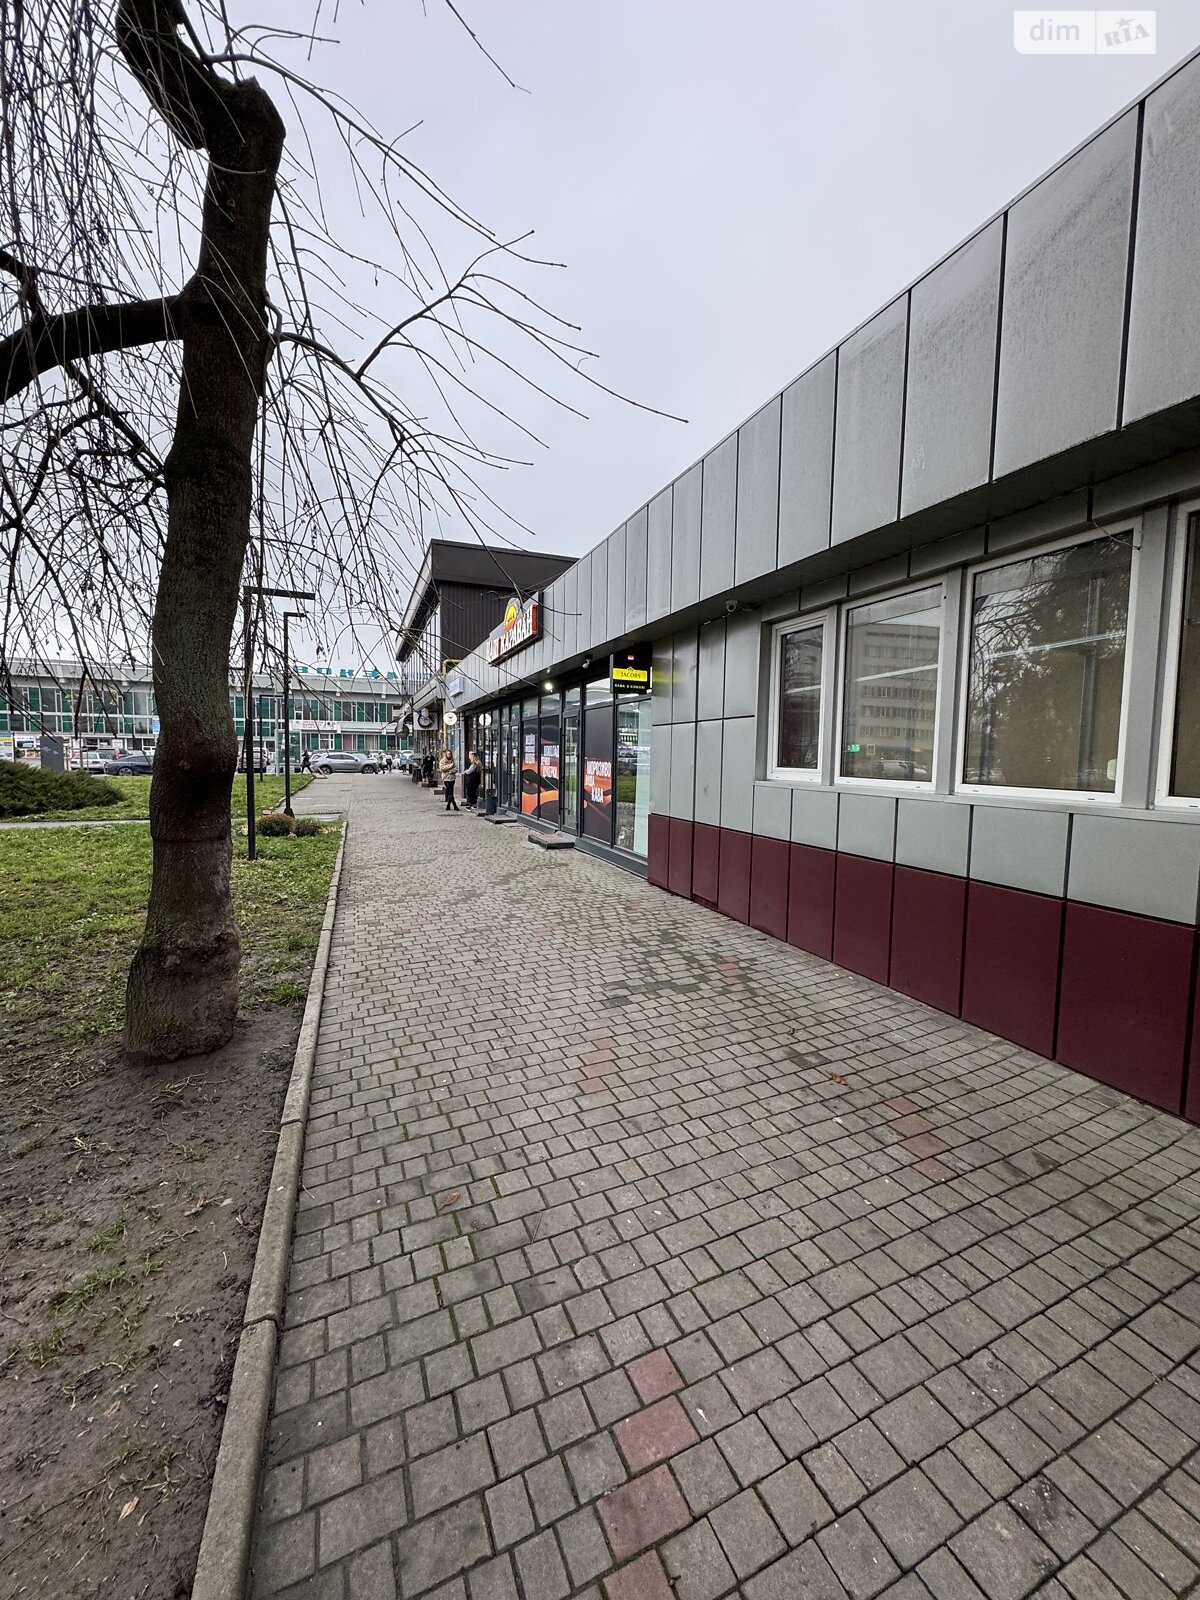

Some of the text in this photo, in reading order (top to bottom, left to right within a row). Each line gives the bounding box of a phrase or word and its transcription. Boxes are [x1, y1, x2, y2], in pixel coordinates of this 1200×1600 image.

[500, 604, 533, 655] КАРАВАН
[620, 671, 641, 679] JACOBS
[586, 760, 612, 777] МОРОЗИВО
[591, 786, 604, 803] КАВА
